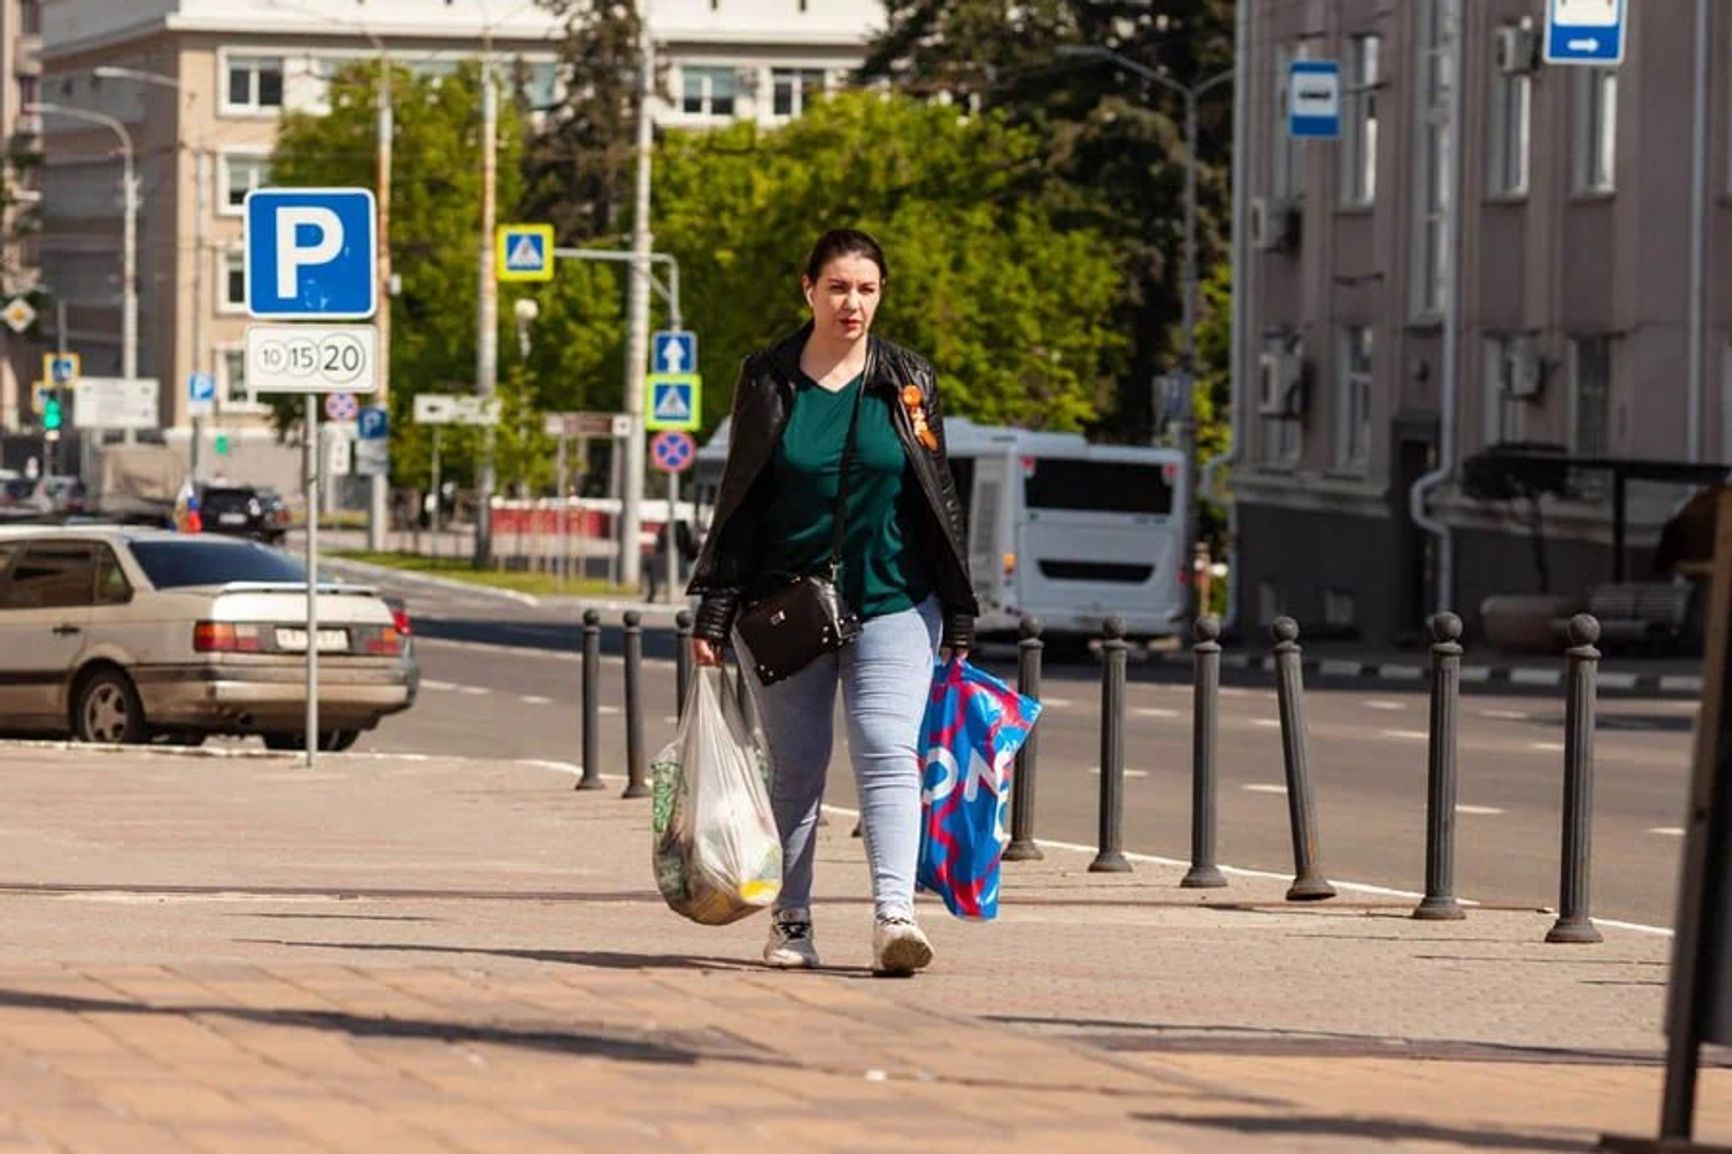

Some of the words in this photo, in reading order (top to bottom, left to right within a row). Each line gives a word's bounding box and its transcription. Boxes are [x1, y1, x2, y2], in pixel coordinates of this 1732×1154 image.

[276, 206, 345, 299] P
[263, 348, 281, 366] 10
[292, 347, 314, 368] 15
[323, 344, 360, 372] 20
[362, 410, 382, 437] P
